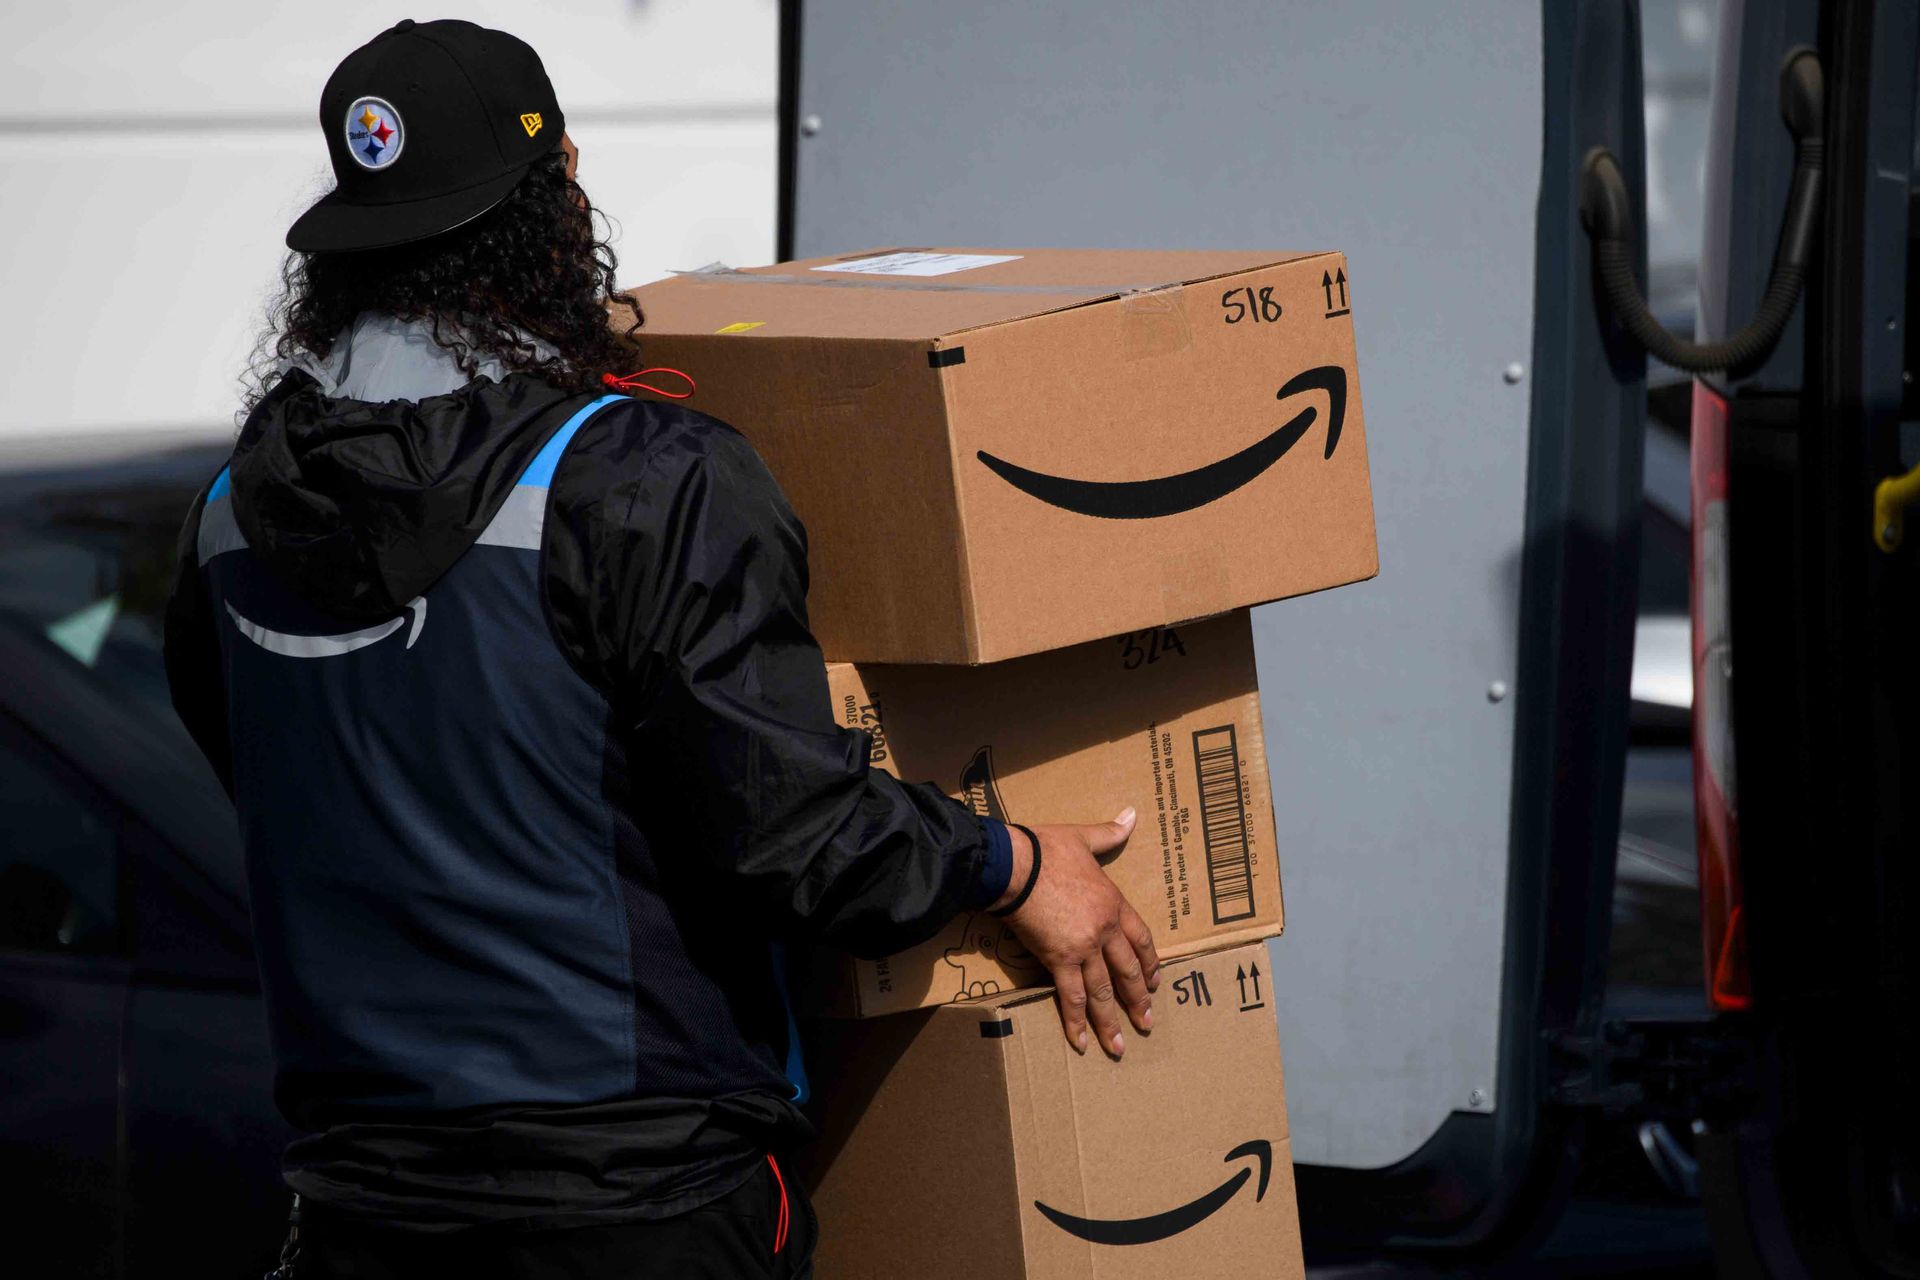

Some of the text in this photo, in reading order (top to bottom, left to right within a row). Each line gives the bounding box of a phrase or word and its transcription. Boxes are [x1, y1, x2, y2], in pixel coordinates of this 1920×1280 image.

[1222, 286, 1282, 324] 518
[844, 694, 858, 725] 37000
[1162, 732, 1173, 756] 45202
[1165, 758, 1173, 769] OH
[1152, 760, 1163, 797] imported
[1166, 770, 1178, 811] Cincinnati,
[1241, 774, 1251, 806] 66821
[965, 781, 990, 817] min
[1156, 796, 1165, 811] and
[1172, 812, 1182, 842] Gamble,
[1180, 807, 1190, 824] P&G
[1158, 812, 1169, 847] domestic
[1245, 812, 1256, 846] 37000
[1163, 848, 1171, 867] from
[1177, 853, 1187, 881] Procter
[1249, 853, 1258, 866] 00
[1164, 869, 1174, 885] USA
[1180, 883, 1189, 893] by
[1166, 886, 1174, 899] the
[1168, 900, 1176, 909] in
[1182, 894, 1190, 916] Distr.
[1168, 908, 1178, 931] Made
[1172, 970, 1212, 1007] 511
